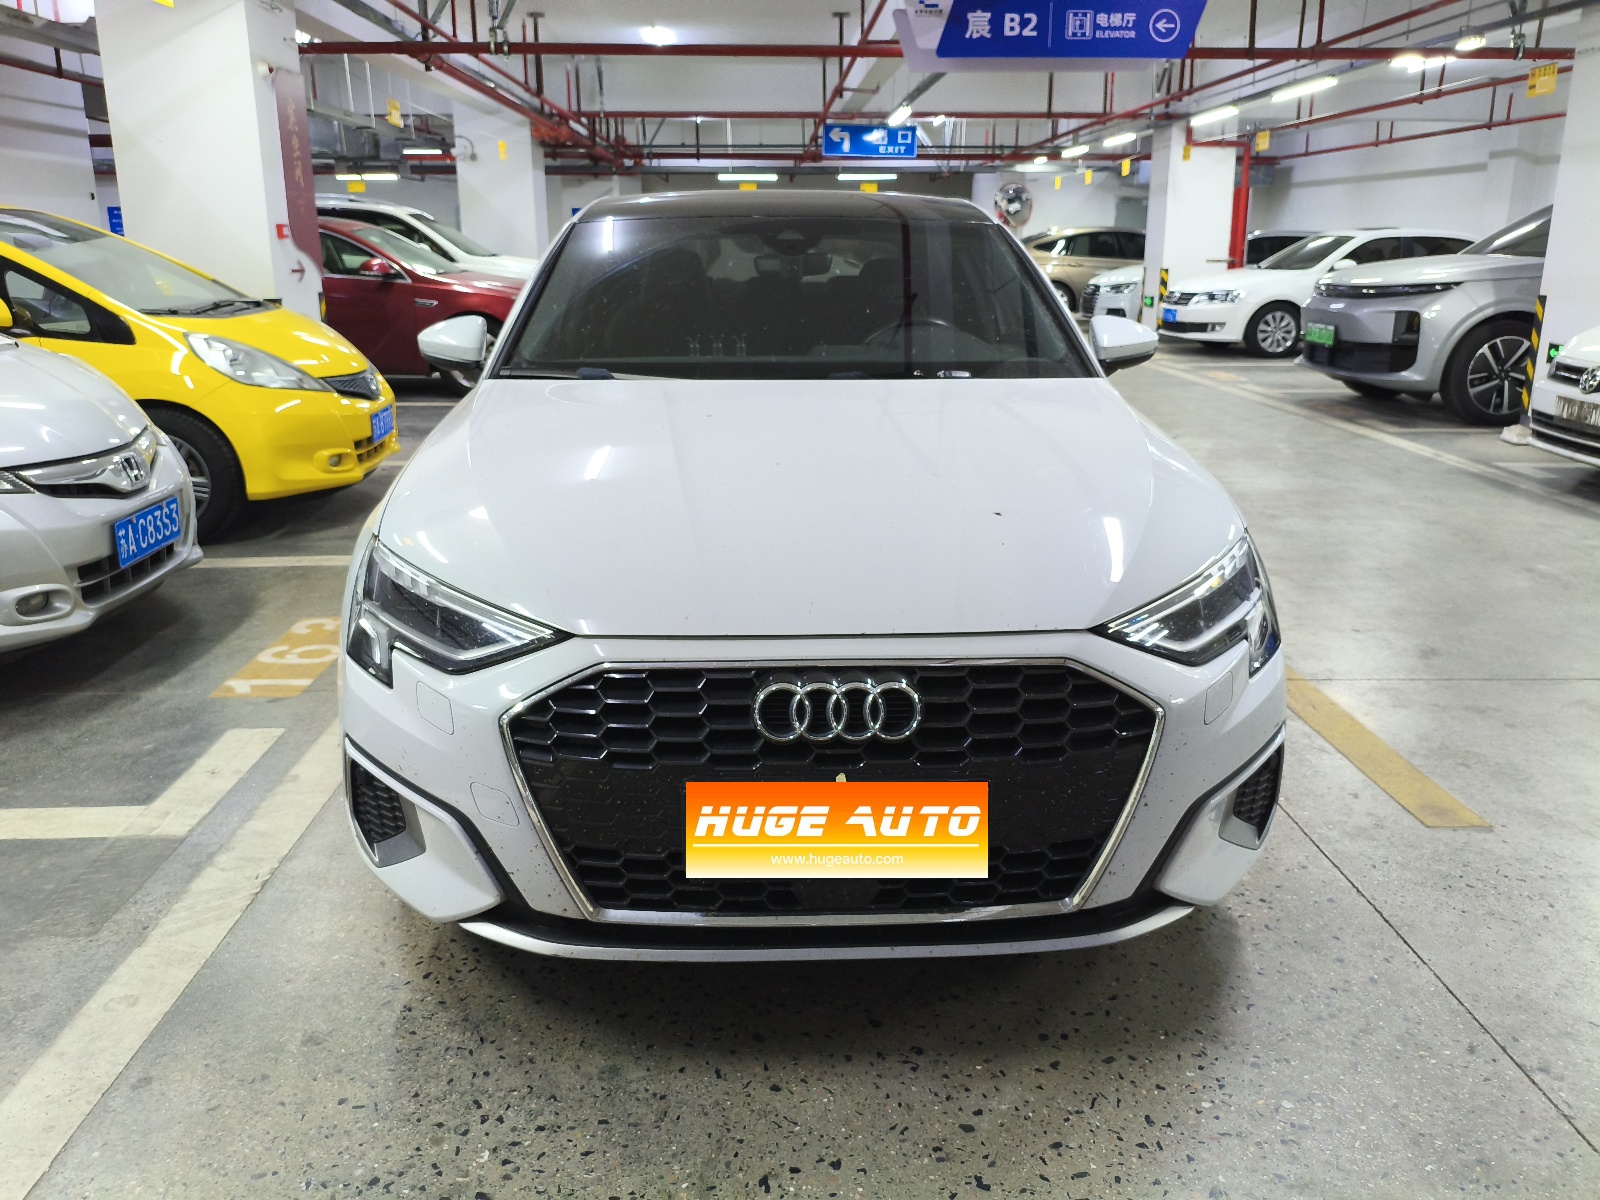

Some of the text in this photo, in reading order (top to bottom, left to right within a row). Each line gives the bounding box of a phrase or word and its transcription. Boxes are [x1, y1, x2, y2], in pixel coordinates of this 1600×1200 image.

[964, 10, 1038, 39] 宸 B2
[1096, 13, 1137, 28] 电梯厅
[1096, 30, 1136, 39] ELEVATOR
[879, 145, 906, 154] EXIT
